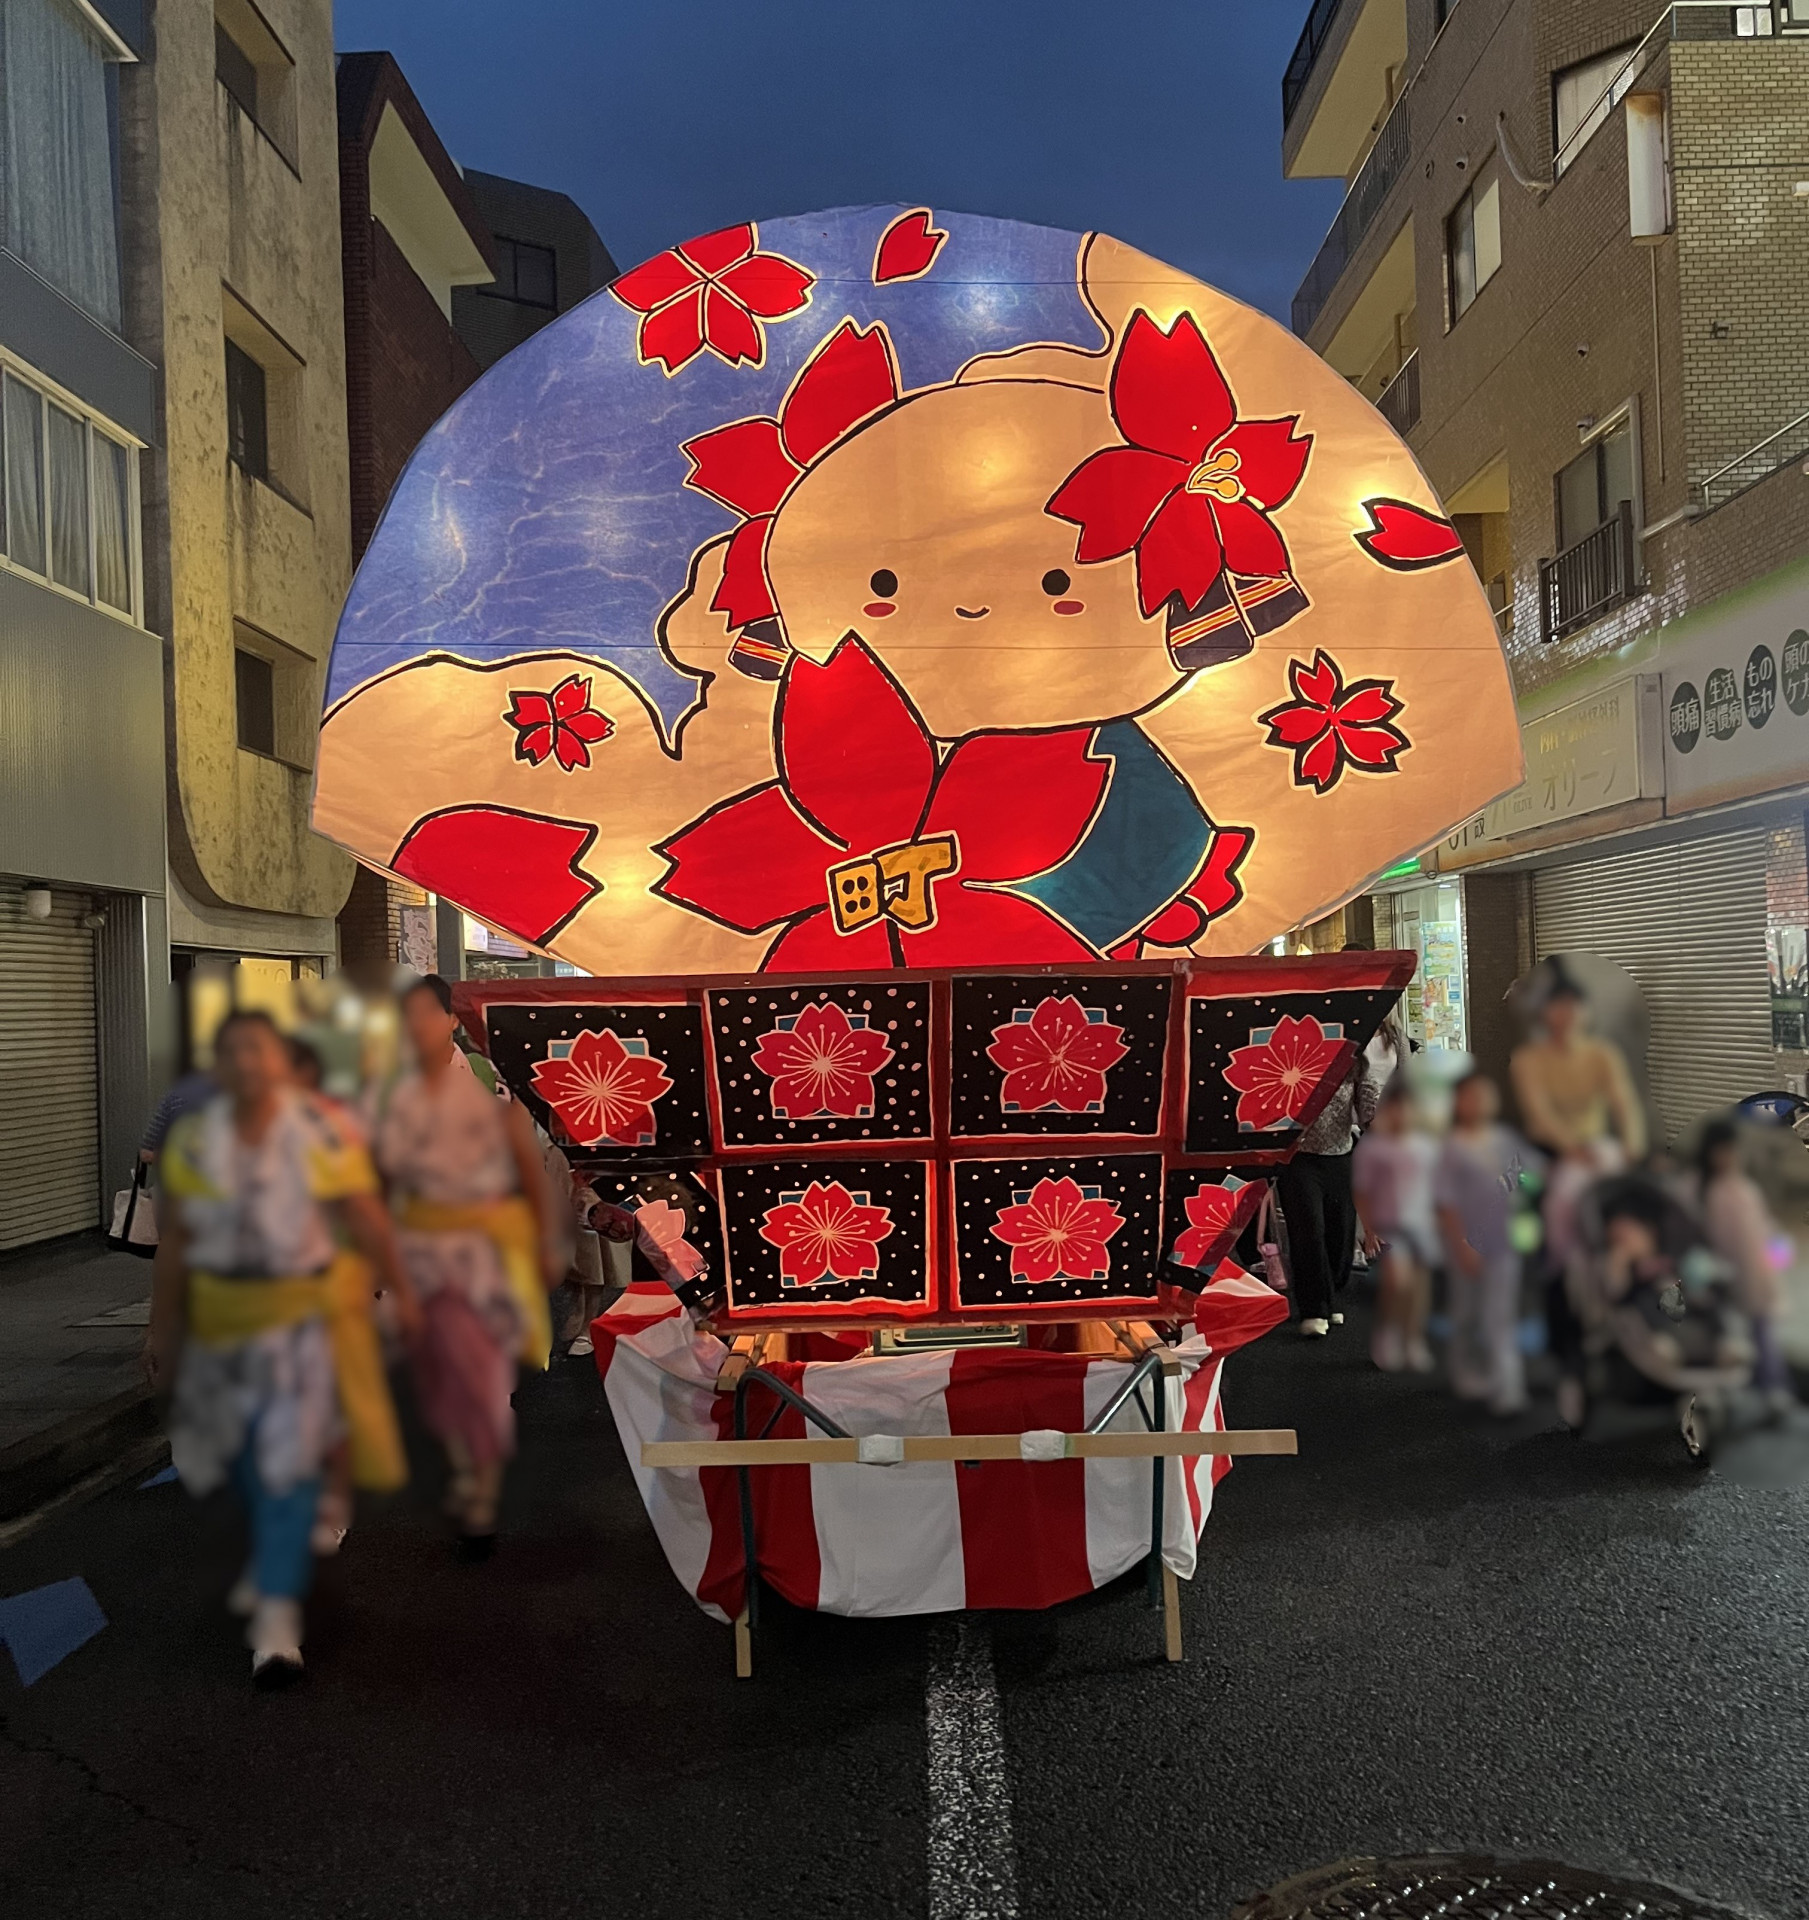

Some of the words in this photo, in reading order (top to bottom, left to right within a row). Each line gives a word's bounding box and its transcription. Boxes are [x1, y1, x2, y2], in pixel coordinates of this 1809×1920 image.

[1709, 672, 1734, 704] 生活
[1747, 657, 1773, 687] もの
[1670, 698, 1700, 736] 頭痛
[1705, 701, 1742, 736] 習慣病
[1747, 687, 1774, 719] 忘れ
